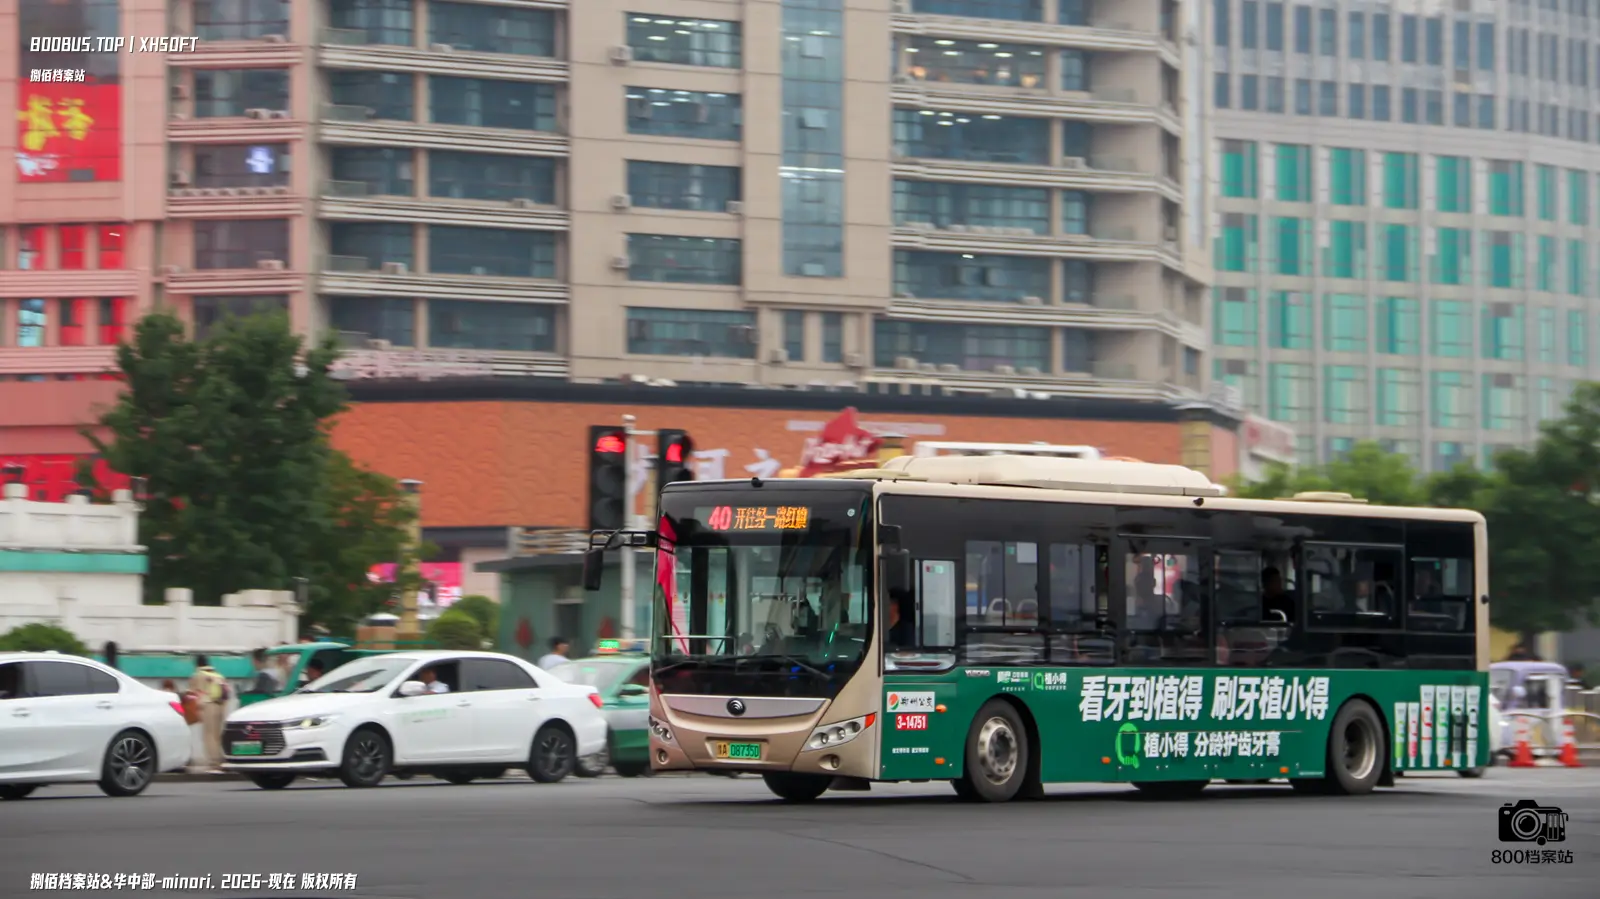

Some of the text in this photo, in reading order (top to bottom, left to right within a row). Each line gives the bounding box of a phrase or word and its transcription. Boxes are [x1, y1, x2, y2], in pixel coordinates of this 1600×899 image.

[708, 506, 732, 530] 40
[1079, 675, 1330, 721] 看牙到植得 刷牙植小得
[897, 715, 926, 729] 3-14751
[1144, 731, 1281, 758] 植小得 分龄护齿牙膏
